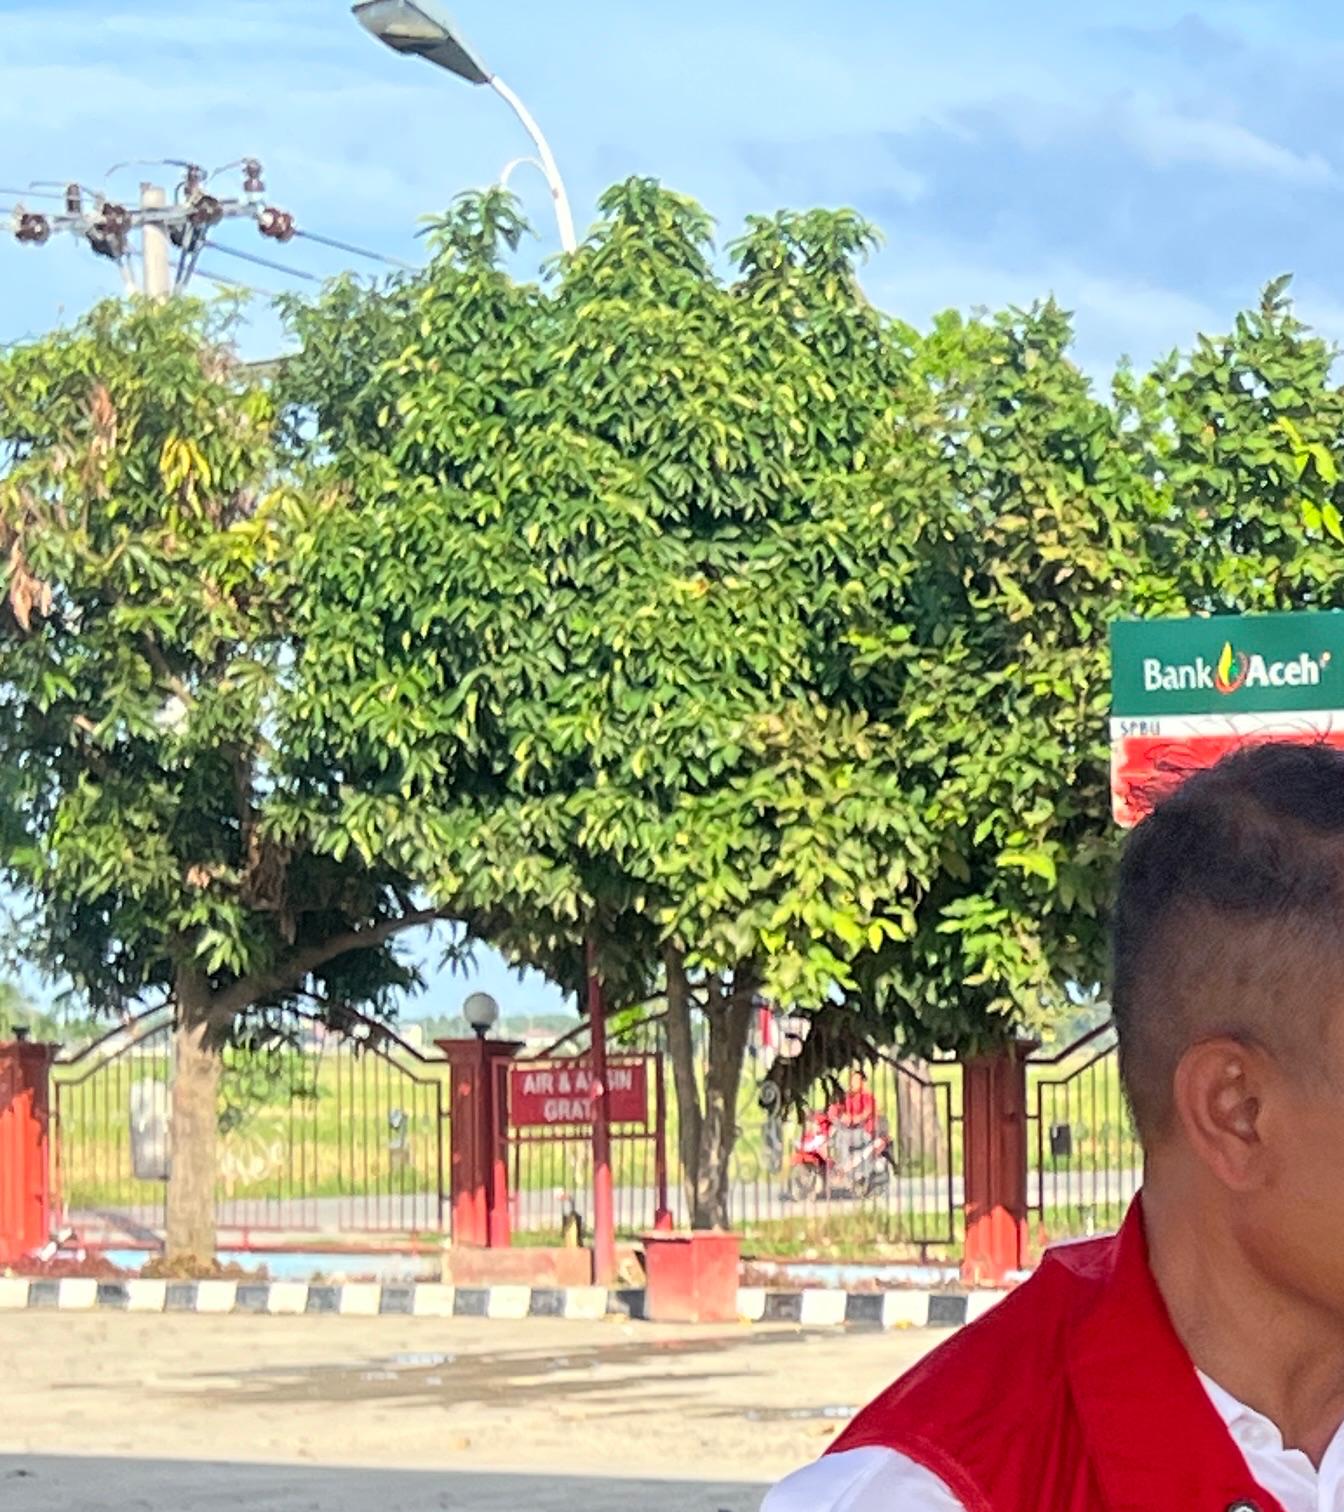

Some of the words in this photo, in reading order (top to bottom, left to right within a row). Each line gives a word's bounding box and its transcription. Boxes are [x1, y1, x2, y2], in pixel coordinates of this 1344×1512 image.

[1143, 657, 1214, 691] Bank
[1246, 652, 1320, 686] Aceh
[1120, 720, 1160, 736] SPBU
[523, 1071, 554, 1096] AIR
